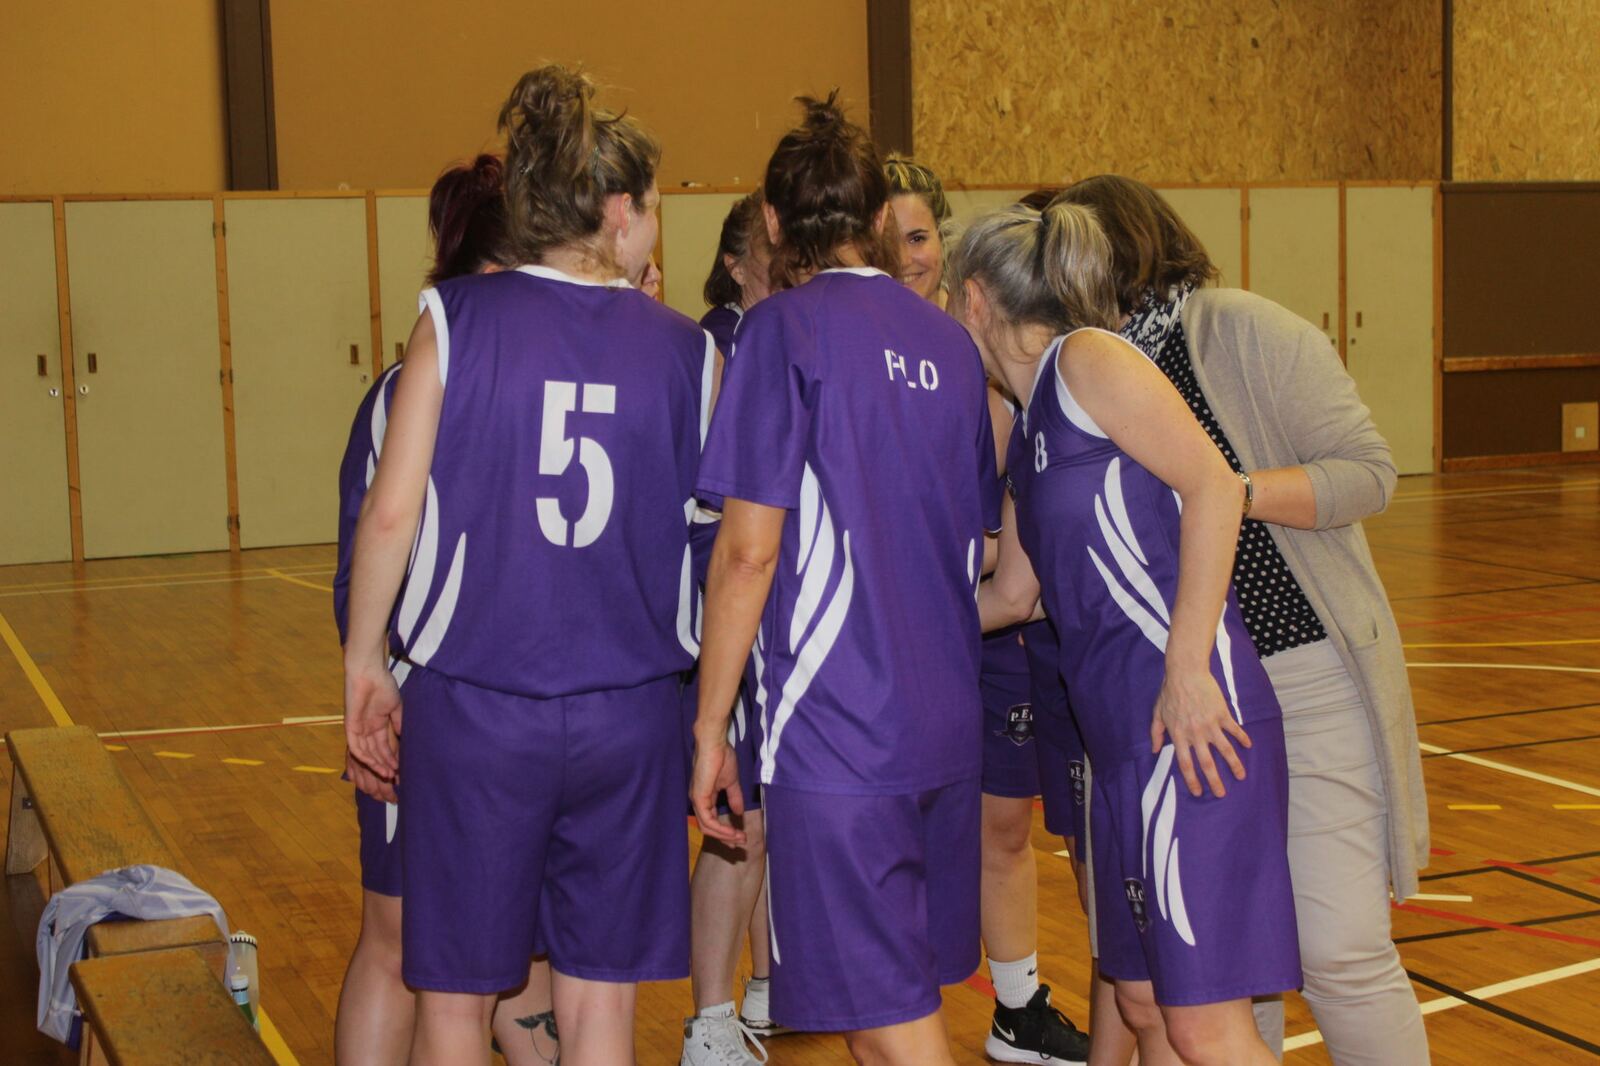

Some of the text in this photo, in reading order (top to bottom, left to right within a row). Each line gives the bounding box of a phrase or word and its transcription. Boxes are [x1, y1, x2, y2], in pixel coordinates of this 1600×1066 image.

[884, 349, 939, 391] FLO
[535, 379, 616, 548] 5
[1034, 431, 1048, 473] 8
